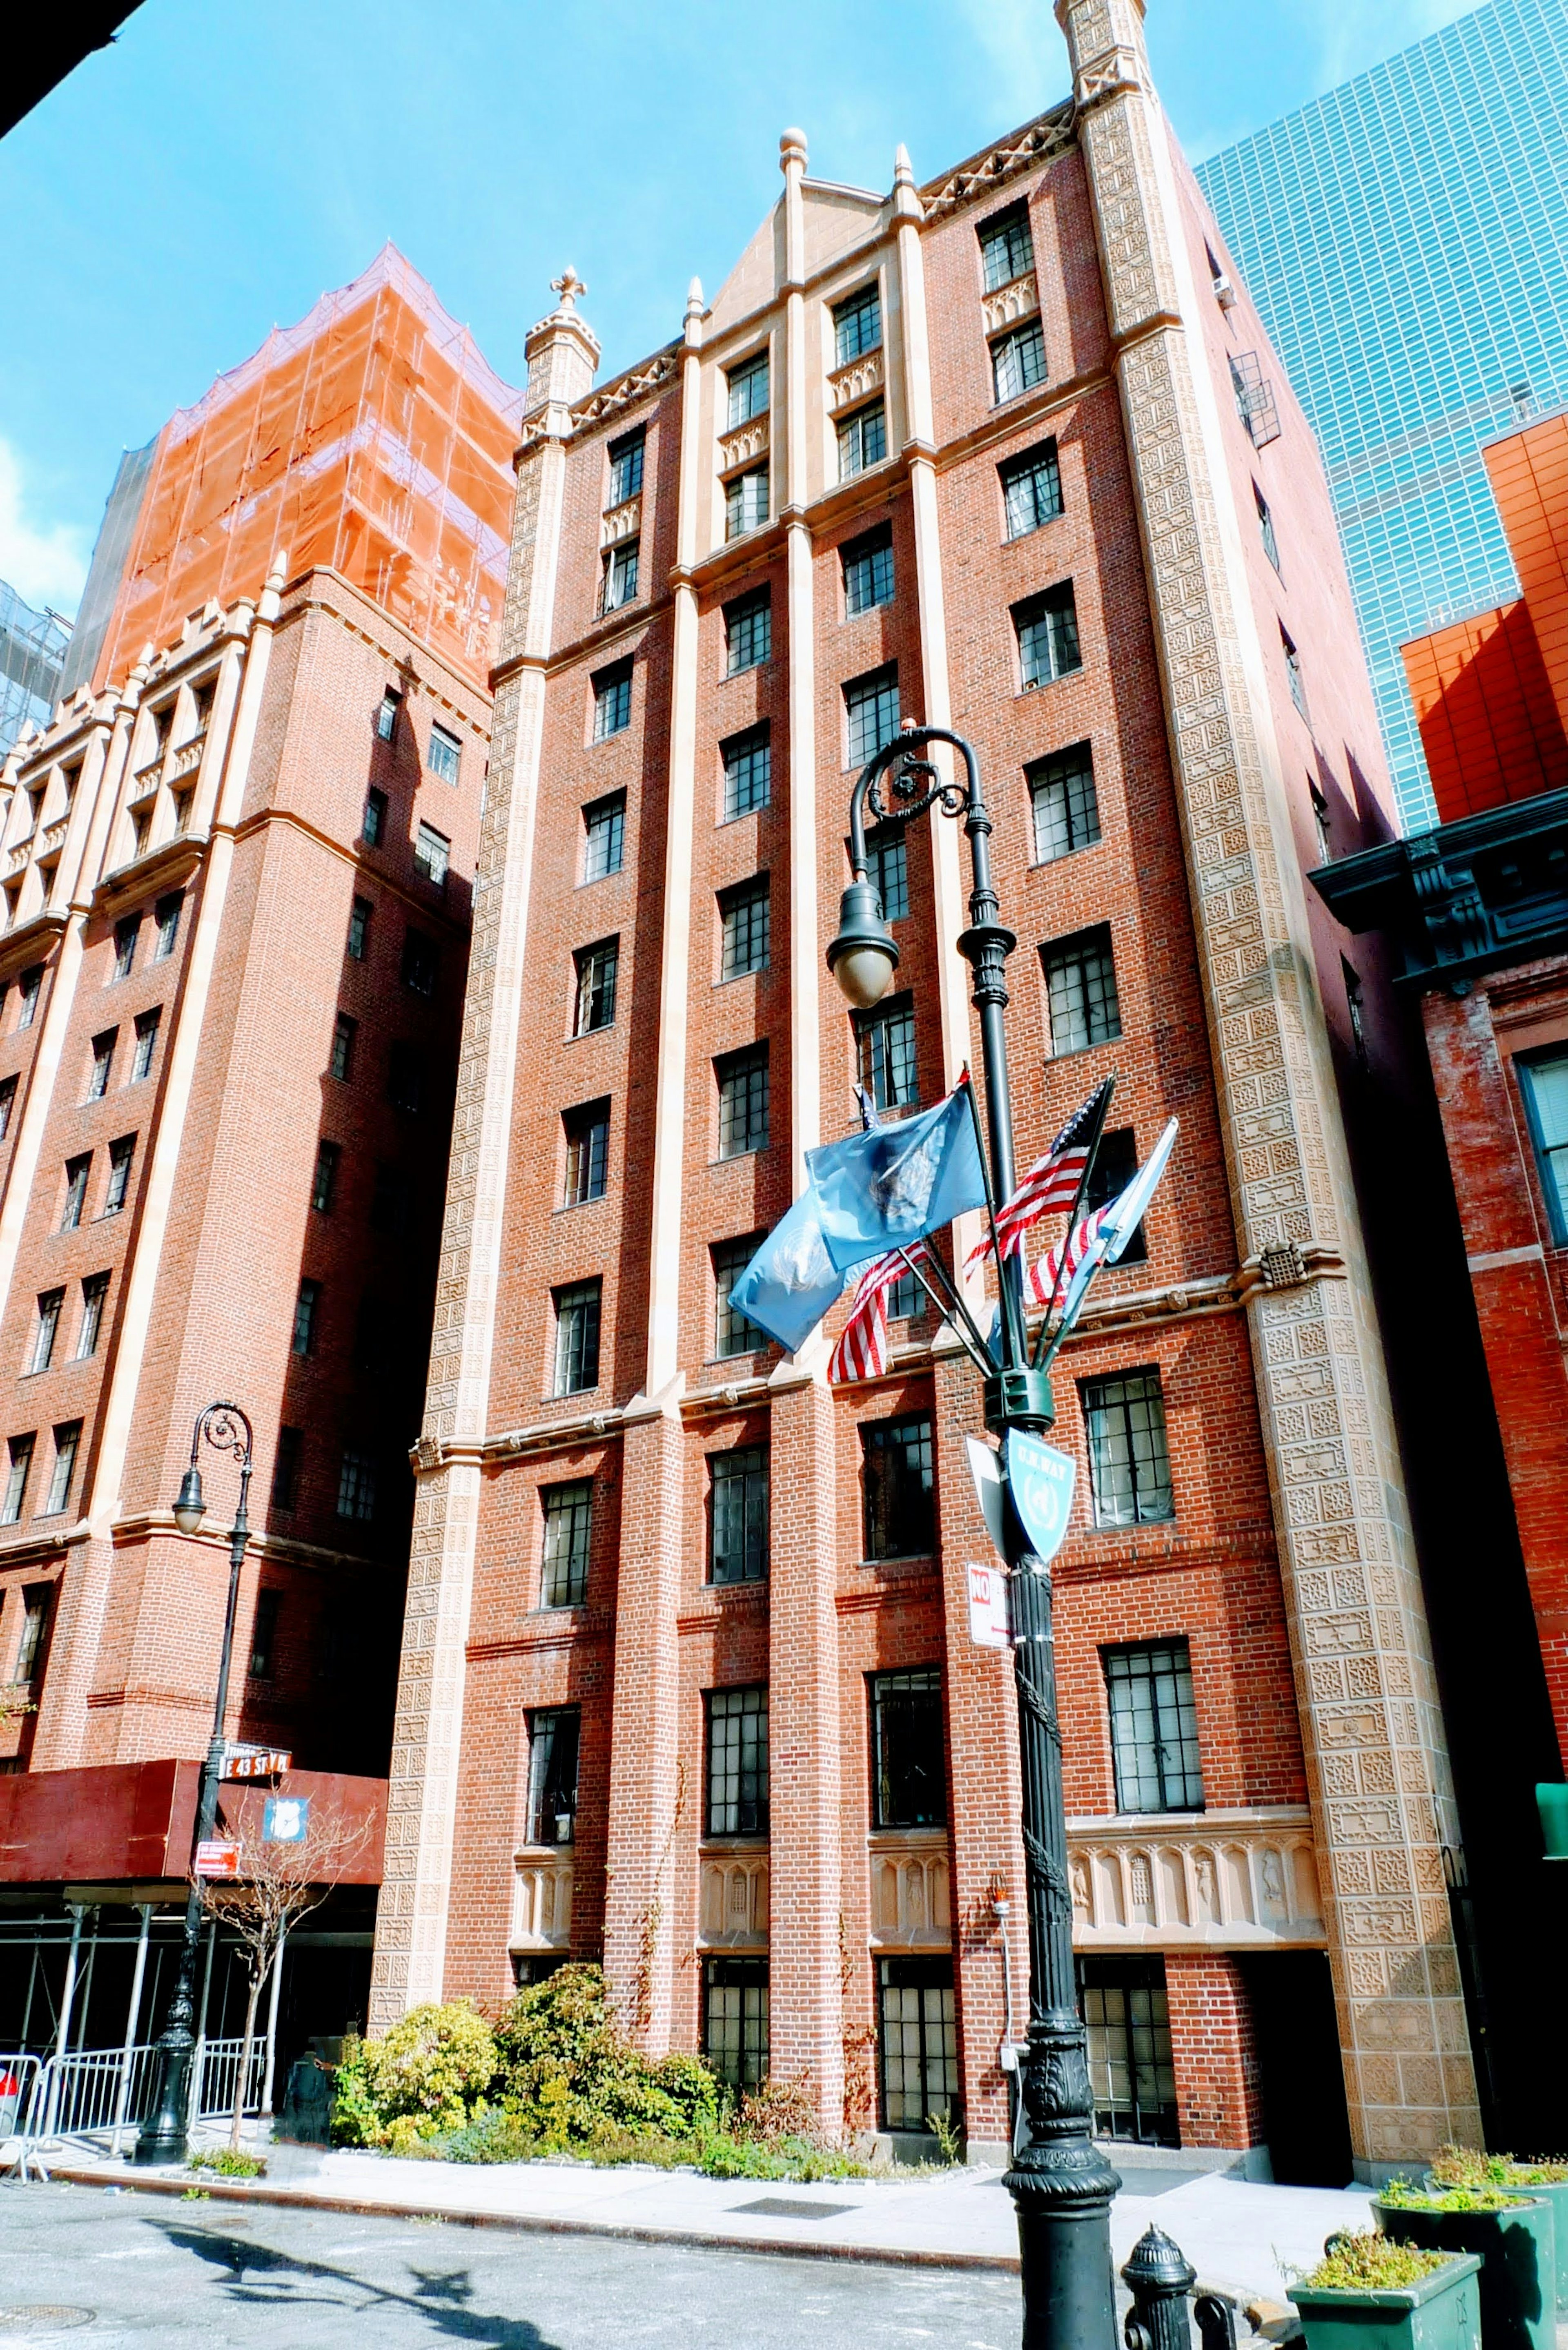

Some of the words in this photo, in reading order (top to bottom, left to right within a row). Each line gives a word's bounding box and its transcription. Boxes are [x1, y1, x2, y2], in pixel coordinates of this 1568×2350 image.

[971, 1573, 989, 1601] NO
[226, 1760, 234, 1777] E
[236, 1758, 251, 1776] 43
[254, 1757, 267, 1775] ST
